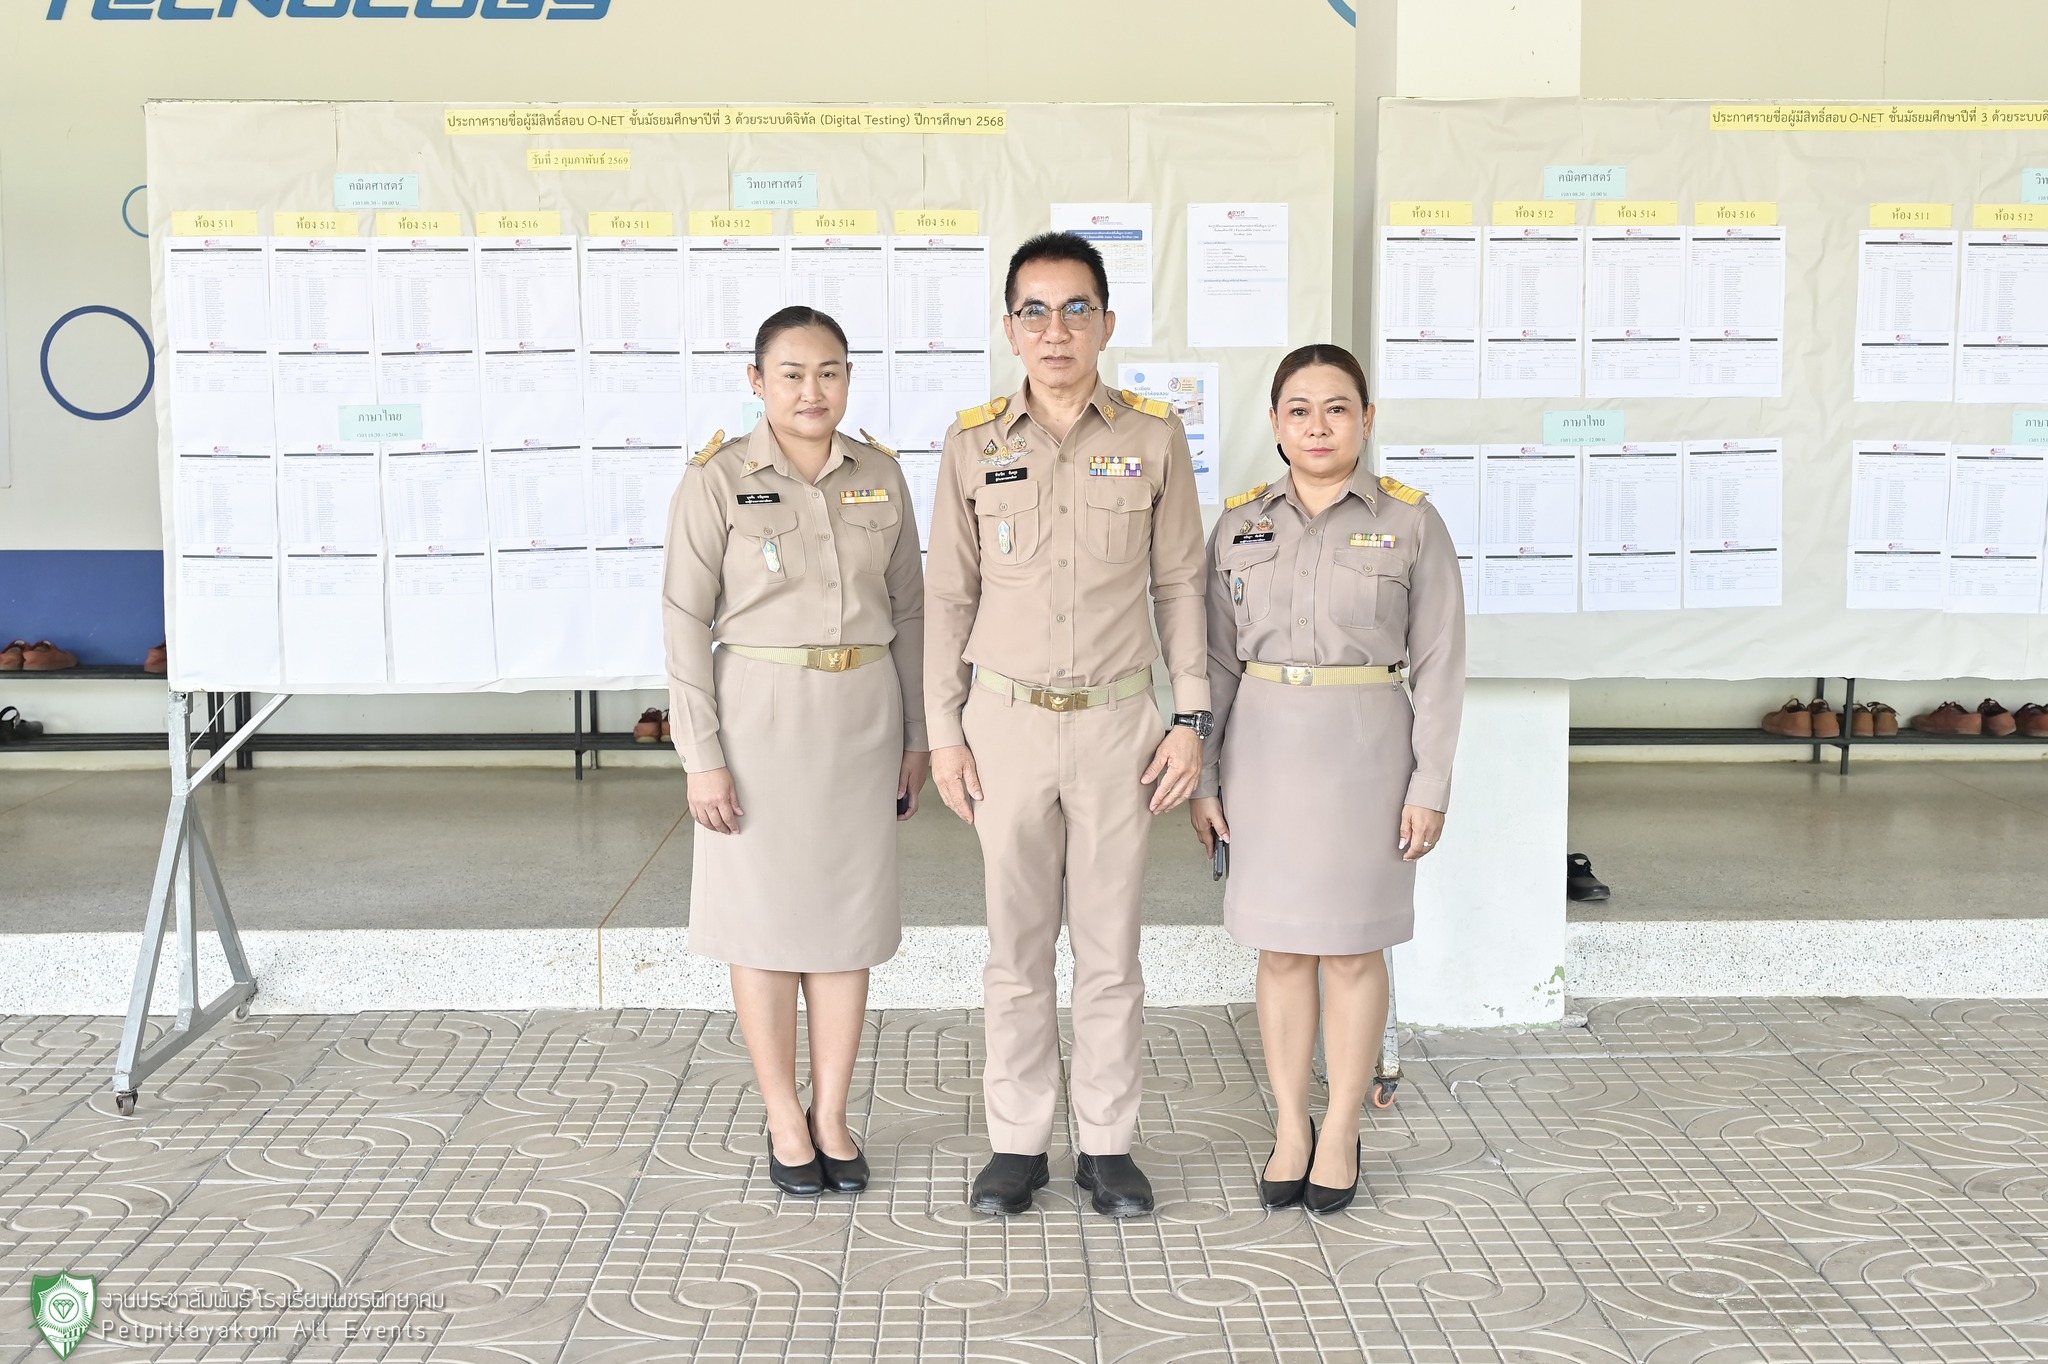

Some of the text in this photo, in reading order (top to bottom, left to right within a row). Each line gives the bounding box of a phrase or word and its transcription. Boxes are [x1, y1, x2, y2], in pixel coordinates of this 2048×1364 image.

[447, 109, 1004, 130] ประกาศรายชื่อผู้มีสิทธิ์สอบ O-NET ชั้นมัธยมศึกษาปีที่ 3 ด้วยระบบดิจิทัล (Digital Testing) ปีการศึกษา 2568
[1713, 107, 1847, 127] ประกาศรายชื่อผู้มีสิทธิ์สอบ
[1849, 113, 1885, 123] O-NET
[1889, 106, 1977, 123] ชั้นมัธยมศึกษาปีที่
[1981, 112, 1988, 122] 3
[532, 150, 628, 167] วันที่ 2 กุมภาพันธ์ 2569
[1558, 168, 1612, 182] คณิตศาสตร์
[349, 177, 404, 191] คณิตศาสตร์
[746, 176, 803, 189] วิทยาศาสตร์
[1412, 205, 1451, 218] ห้อง 511
[1515, 205, 1554, 218] ห้อง 512
[1617, 205, 1656, 218] ห้อง 514
[1717, 206, 1756, 219] ห้อง 516
[1892, 207, 1929, 220] ห้อง 511
[1995, 208, 2033, 221] ห้อง 512
[195, 215, 234, 228] ห้อง 511
[296, 217, 336, 230] ห้อง 512
[398, 216, 439, 230] ห้อง 514
[498, 216, 538, 229] ห้อง 516
[610, 216, 649, 229] ห้อง 511
[711, 215, 750, 228] ห้อง 512
[815, 214, 855, 228] ห้อง 514
[917, 214, 957, 227] ห้อง 516
[358, 409, 402, 422] ภาษาไทย
[1563, 414, 1605, 427] ภาษาไทย
